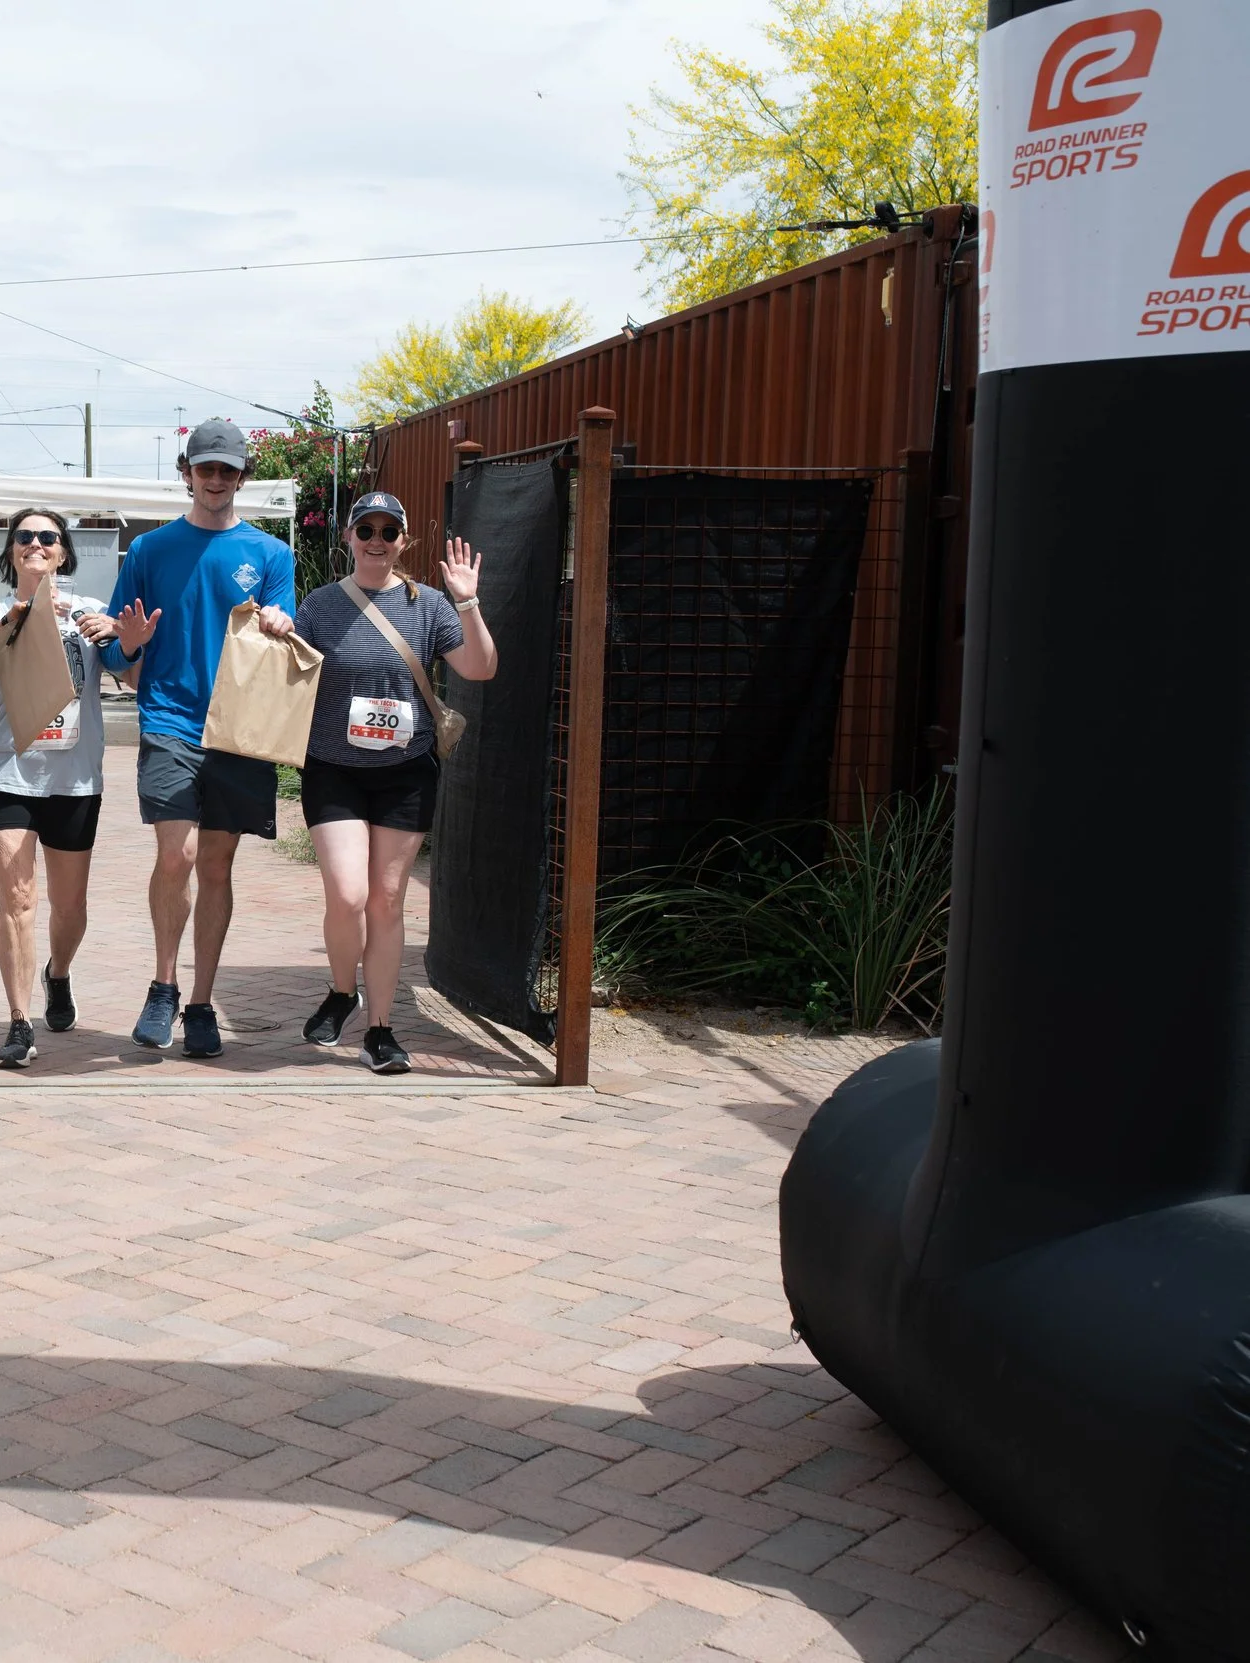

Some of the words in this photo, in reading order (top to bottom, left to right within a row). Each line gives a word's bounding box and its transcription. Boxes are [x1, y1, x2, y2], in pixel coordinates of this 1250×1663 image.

[1015, 138, 1056, 160] ROAD
[1059, 122, 1147, 150] RUNNER
[1010, 142, 1142, 189] SPORTS
[1146, 287, 1215, 306] ROAD
[1136, 303, 1250, 336] SPOR
[46, 715, 64, 728] 9
[365, 712, 399, 728] 230
